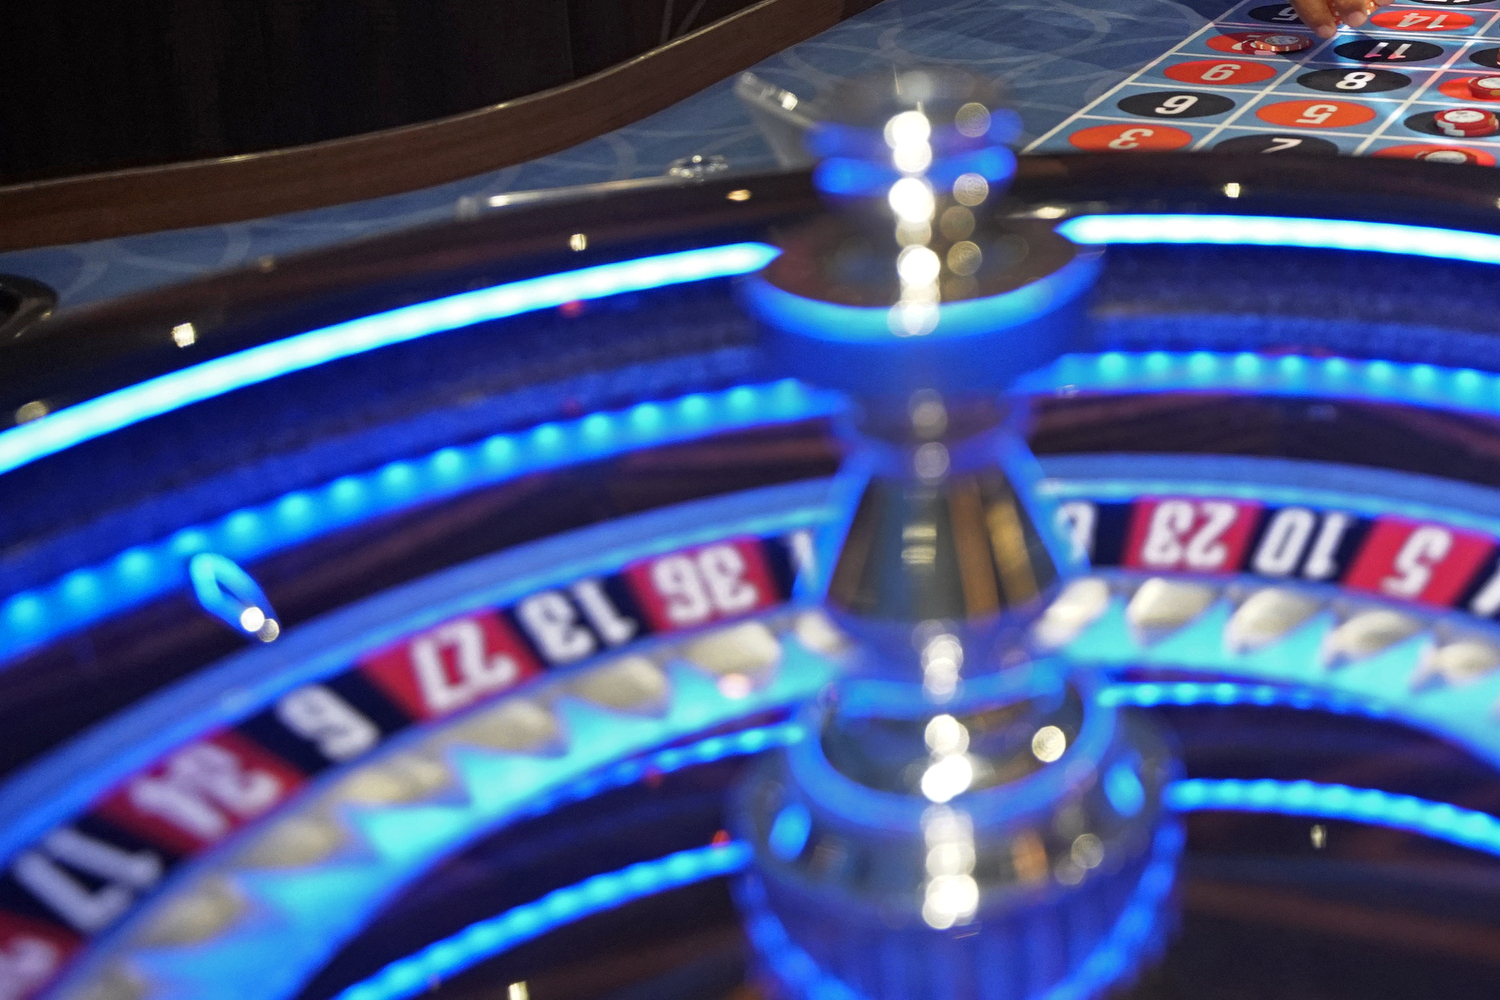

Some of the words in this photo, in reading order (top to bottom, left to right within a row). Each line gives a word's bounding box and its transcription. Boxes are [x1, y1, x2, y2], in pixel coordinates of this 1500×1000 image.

[1271, 5, 1299, 22] 5
[1395, 12, 1451, 30] 14
[1199, 63, 1242, 82] 9
[1363, 41, 1413, 60] 11
[1154, 94, 1200, 115] 6
[1334, 71, 1377, 91] 8
[1294, 103, 1340, 125] 5
[1106, 127, 1155, 151] 3
[1140, 499, 1239, 571] 23
[1251, 505, 1356, 579] 10
[1378, 522, 1453, 599] 5
[648, 545, 760, 626] 36
[515, 576, 643, 666] 13
[409, 615, 520, 714] 27
[127, 730, 286, 838] 34
[13, 824, 162, 933] 17
